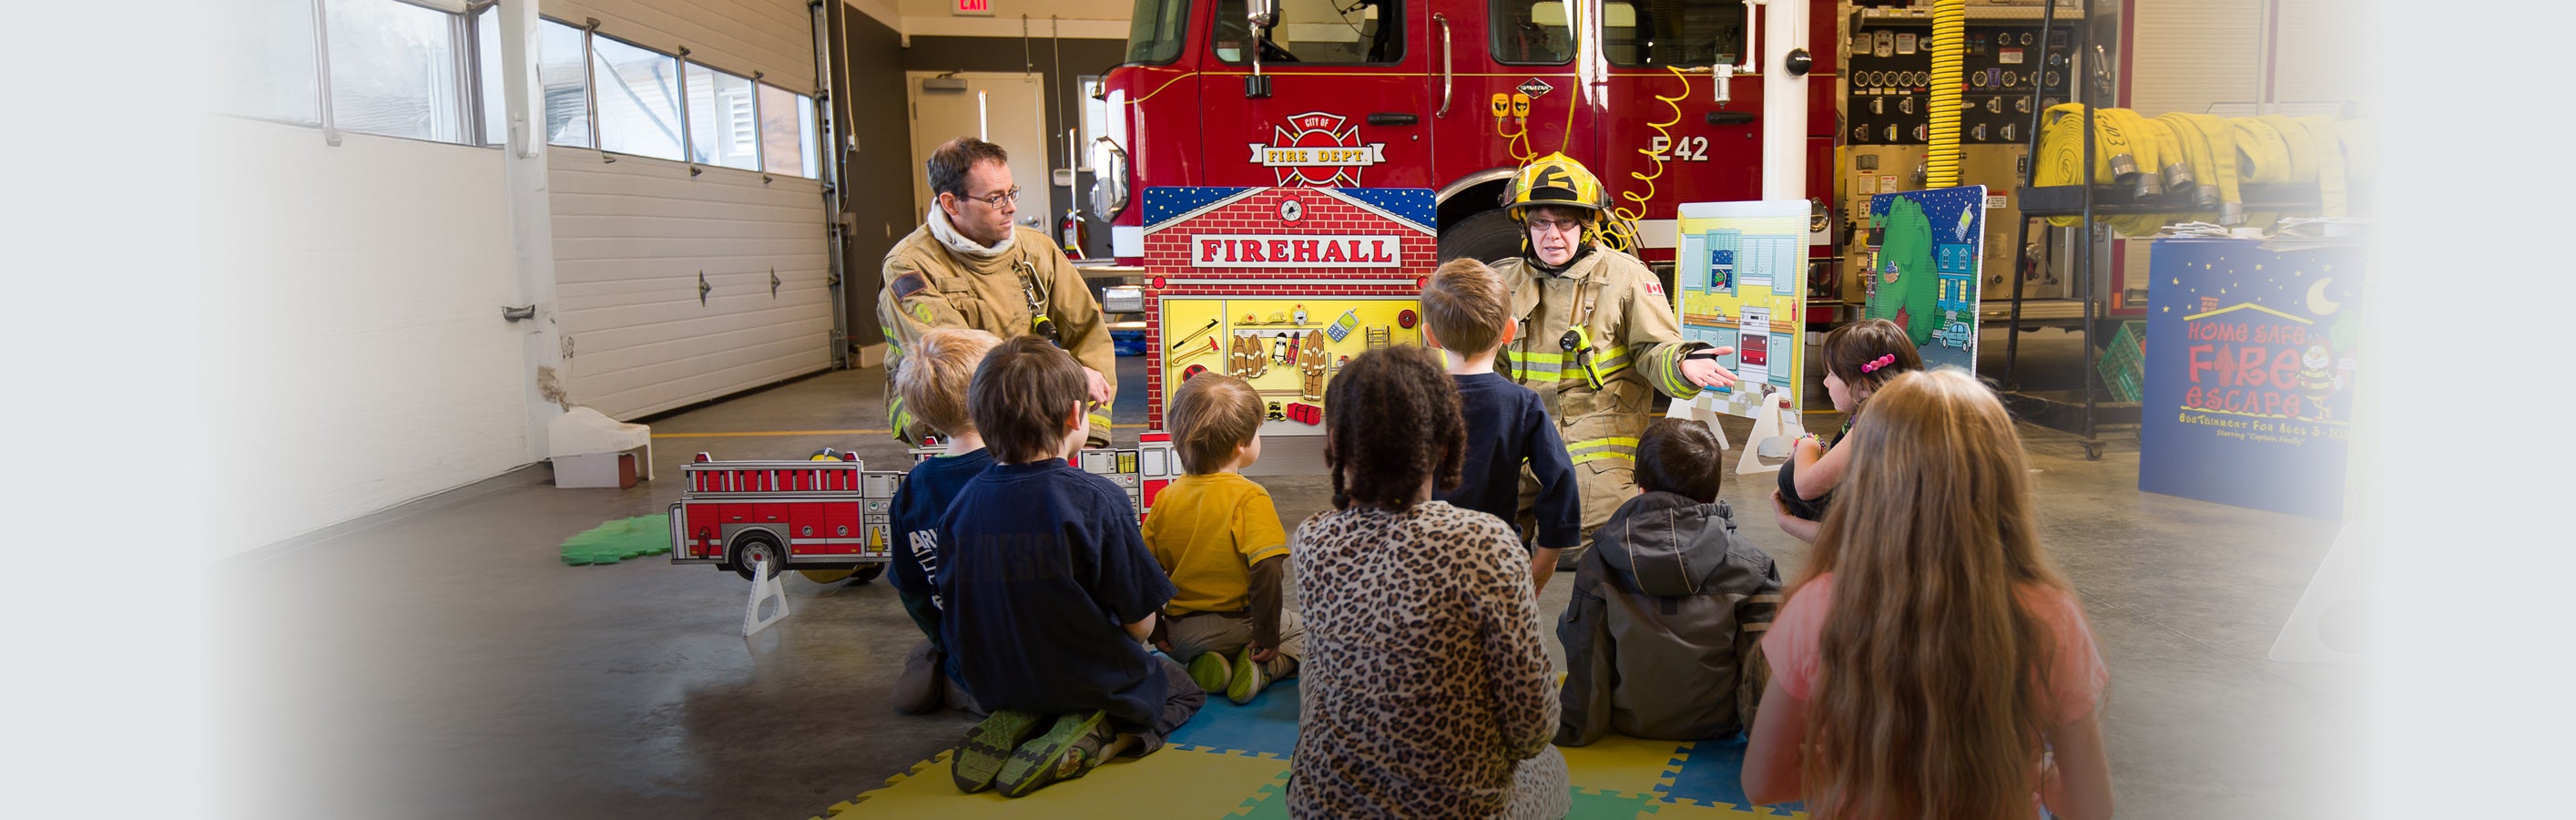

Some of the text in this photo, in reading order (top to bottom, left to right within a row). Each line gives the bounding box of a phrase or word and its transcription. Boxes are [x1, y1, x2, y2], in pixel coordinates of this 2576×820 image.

[1305, 118, 1329, 128] CITY OF
[1268, 150, 1369, 162] FIRE DEPT.
[1200, 239, 1393, 263] FIREHALL
[2216, 429, 2245, 441] Starring
